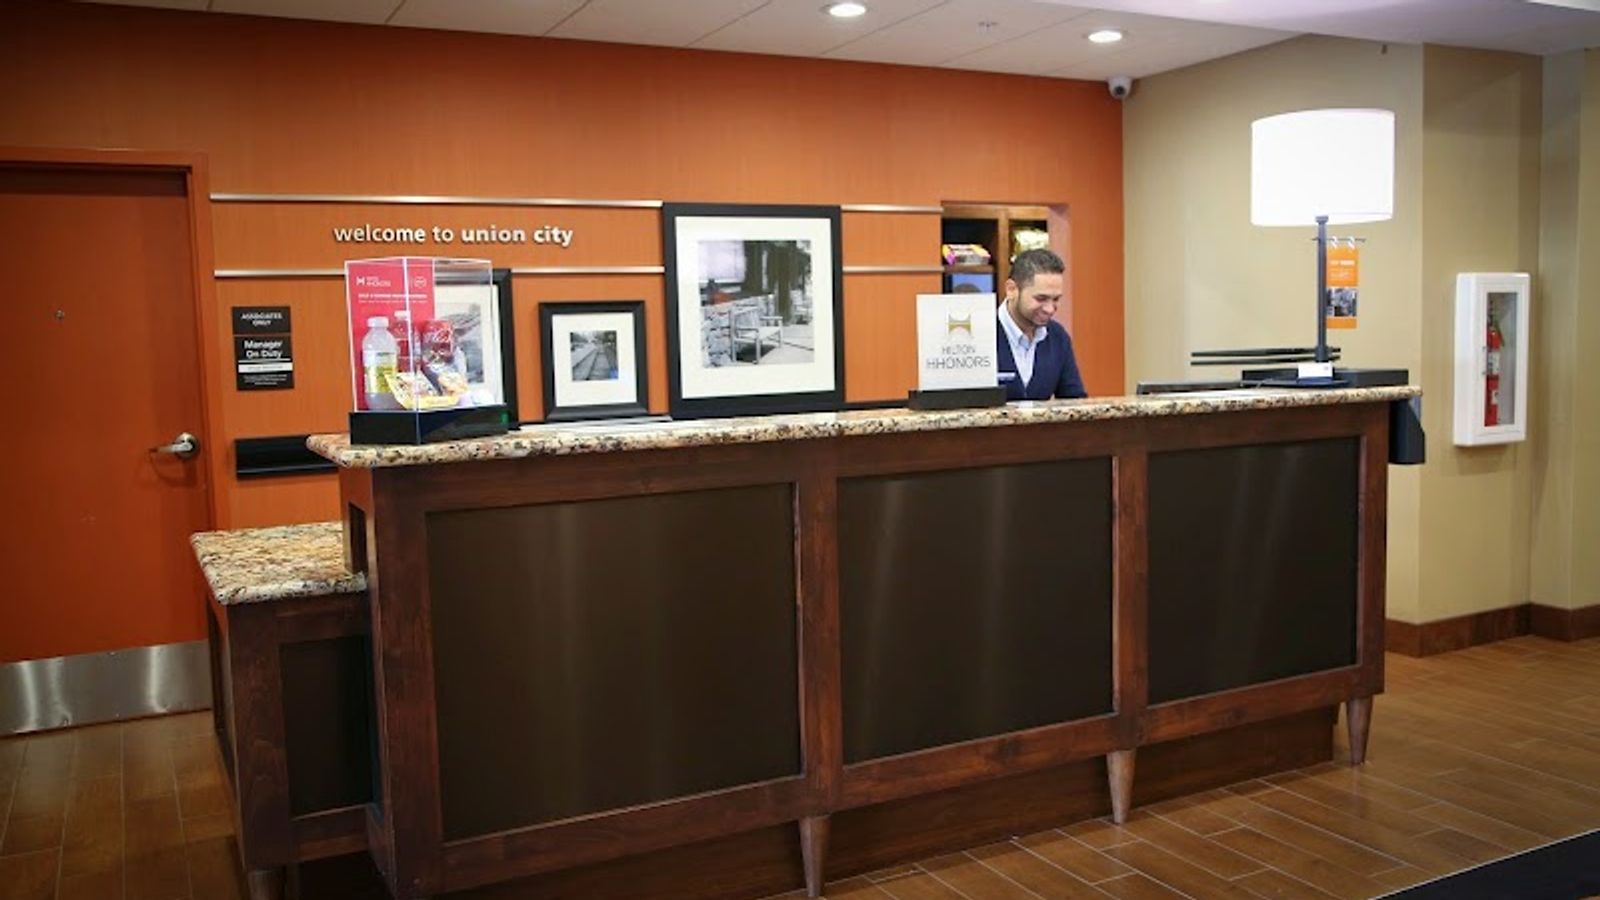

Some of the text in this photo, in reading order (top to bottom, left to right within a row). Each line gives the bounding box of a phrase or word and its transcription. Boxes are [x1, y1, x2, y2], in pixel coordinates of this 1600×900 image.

[334, 224, 573, 247] welcome to union city
[244, 340, 283, 350] Manager
[942, 344, 976, 355] HILTON
[246, 350, 283, 359] On Duty
[926, 356, 991, 369] HHONORS
